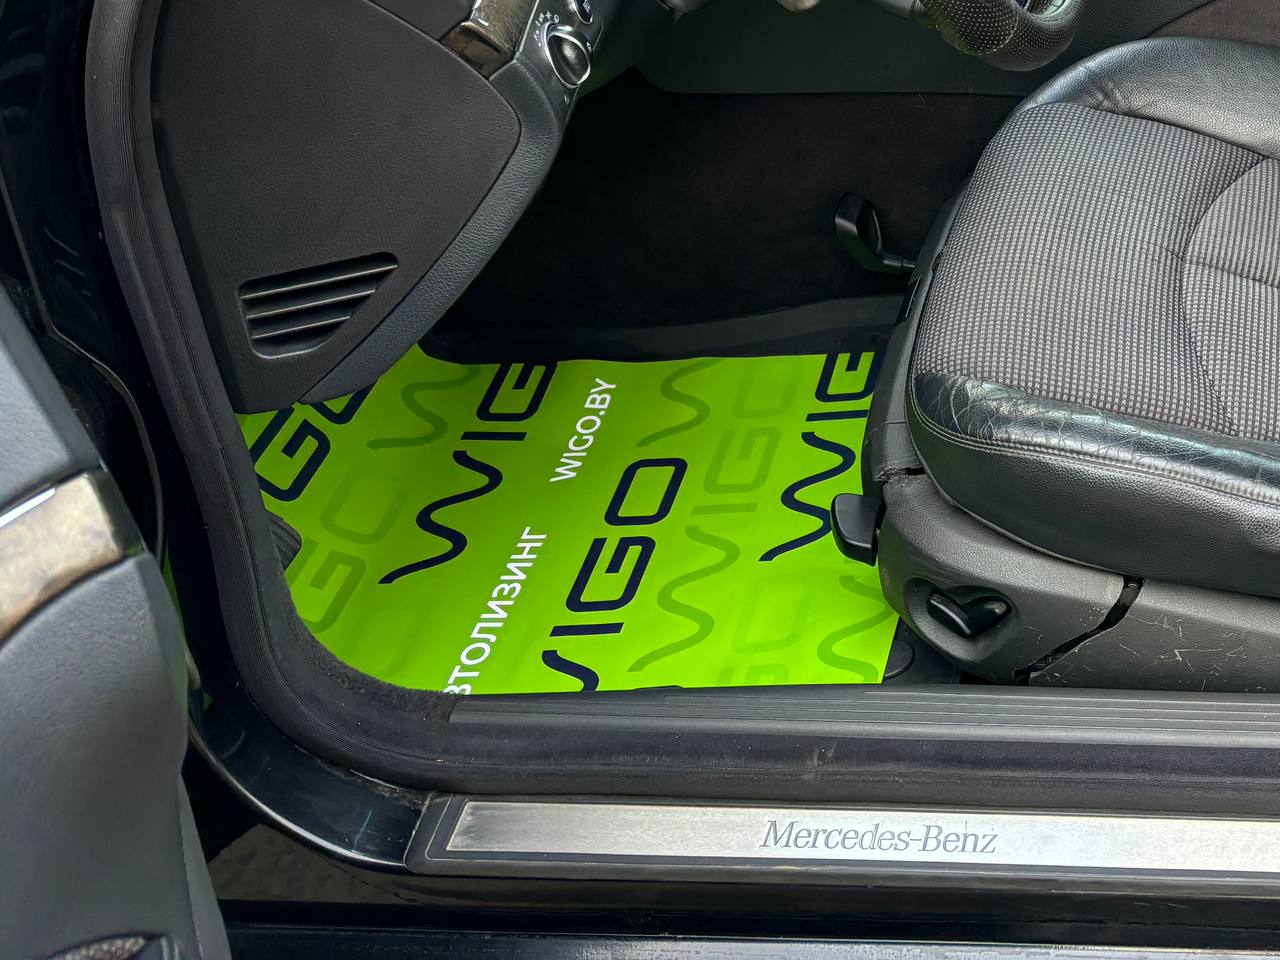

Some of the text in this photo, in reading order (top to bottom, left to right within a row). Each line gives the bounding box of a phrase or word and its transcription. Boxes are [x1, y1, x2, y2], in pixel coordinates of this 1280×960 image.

[378, 359, 558, 584] WIG
[549, 377, 617, 483] WIGO.BY
[759, 351, 877, 562] WIG
[443, 526, 548, 696] ВТОЛИЗИНГ
[759, 819, 999, 855] Mercedes-Benz
